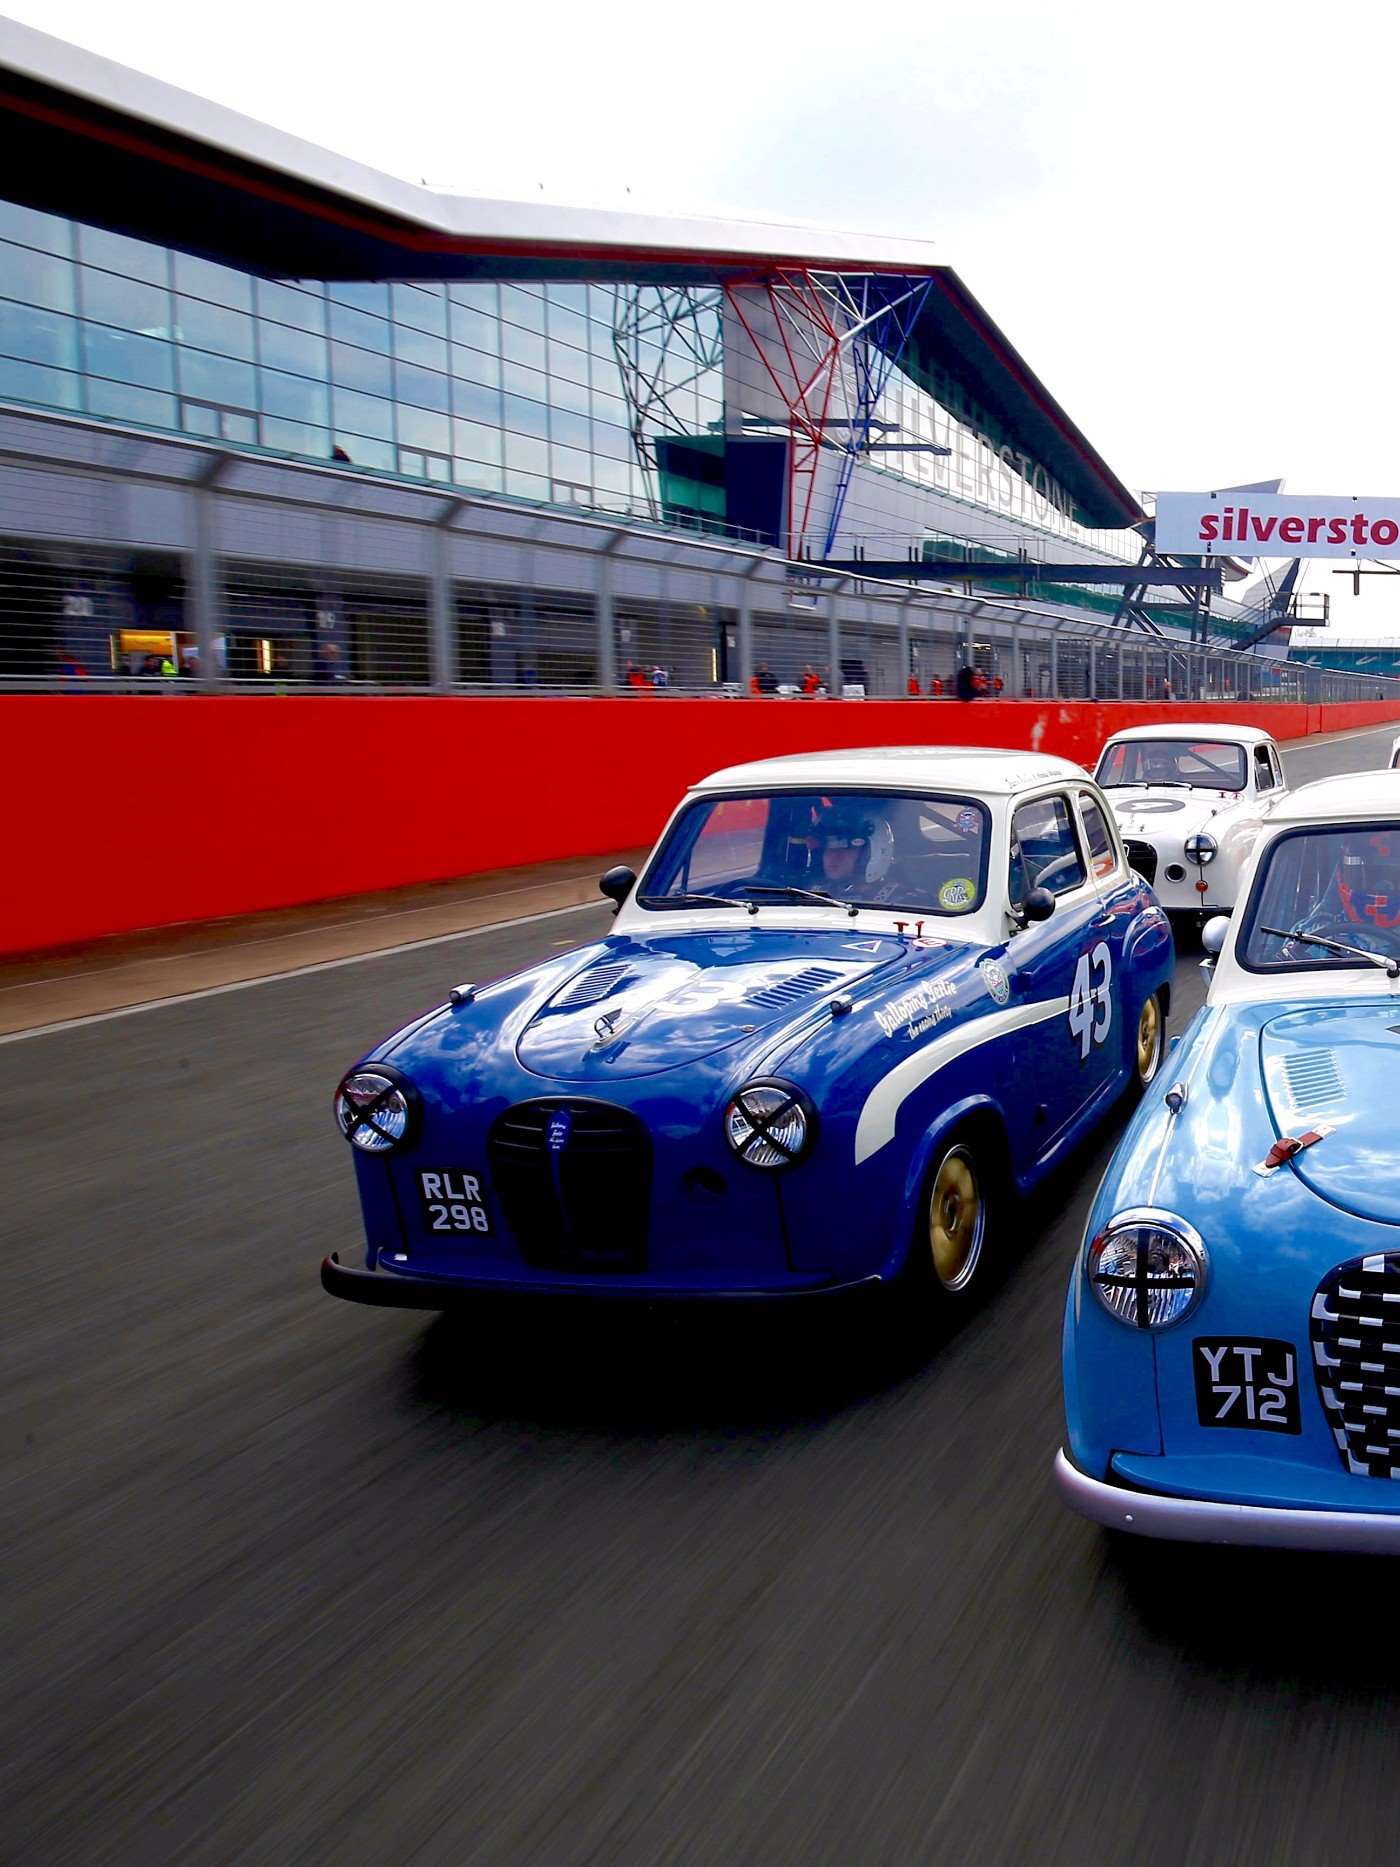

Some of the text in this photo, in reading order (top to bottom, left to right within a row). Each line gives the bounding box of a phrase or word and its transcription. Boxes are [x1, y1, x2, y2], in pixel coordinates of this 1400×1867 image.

[1069, 942, 1112, 1060] 43
[421, 1173, 482, 1202] RLR
[428, 1204, 489, 1232] 298
[1199, 1346, 1294, 1387] YTJ
[1211, 1385, 1288, 1424] 712
